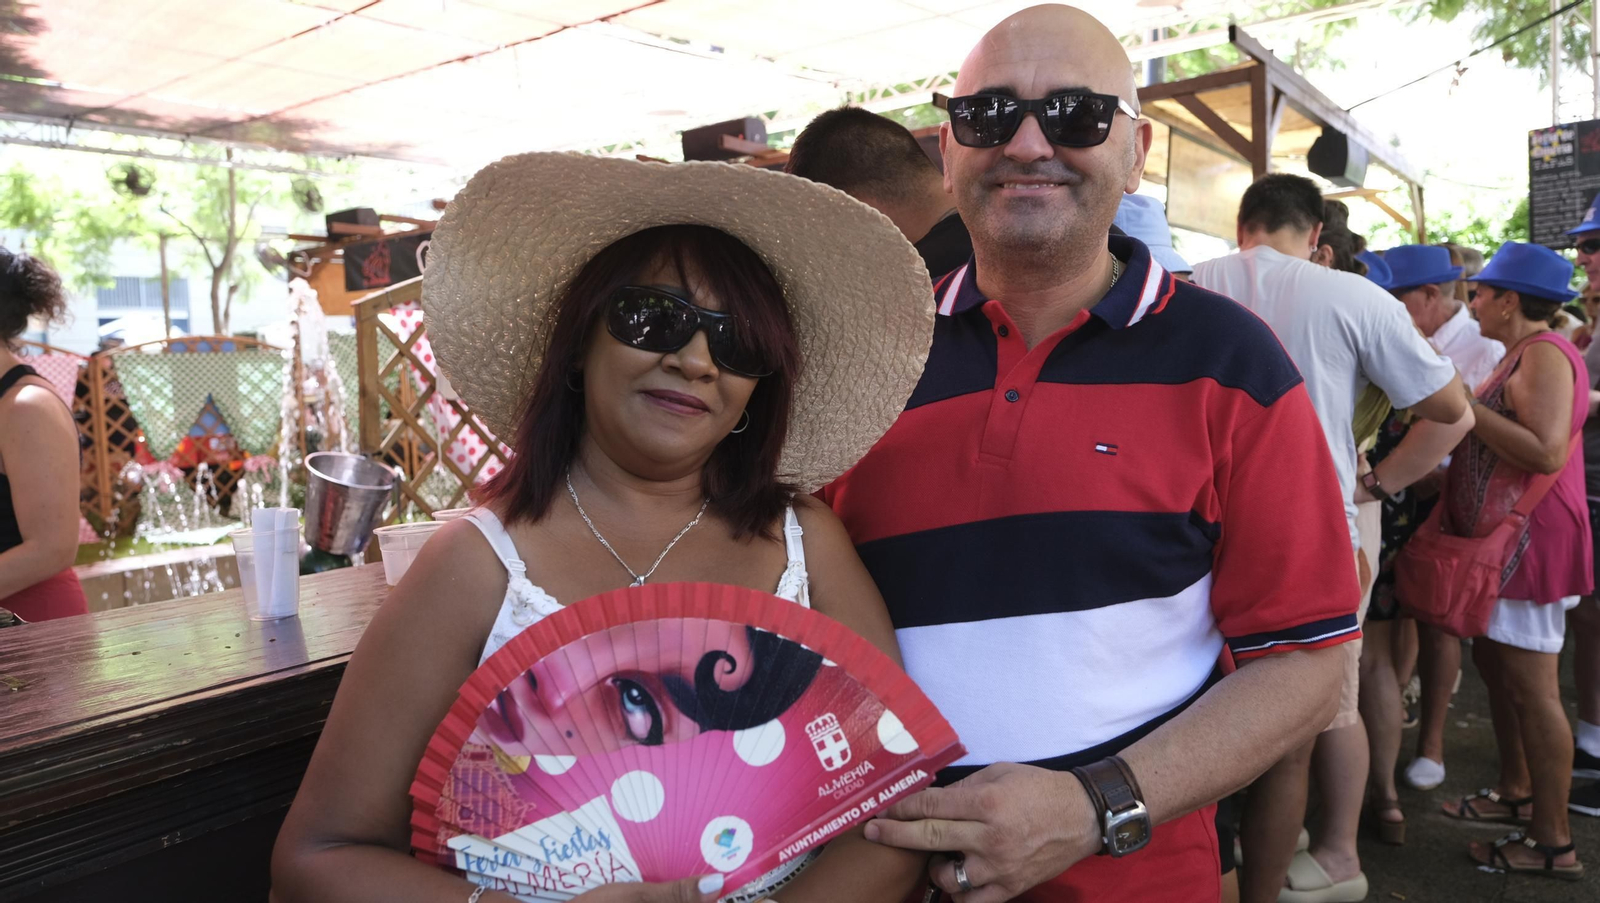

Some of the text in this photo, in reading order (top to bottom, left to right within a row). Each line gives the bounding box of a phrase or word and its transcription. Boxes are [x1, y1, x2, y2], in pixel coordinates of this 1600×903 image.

[539, 826, 612, 864] Fiestas
[778, 768, 928, 862] AYUNTAMIENTO DE ALMERÍA
